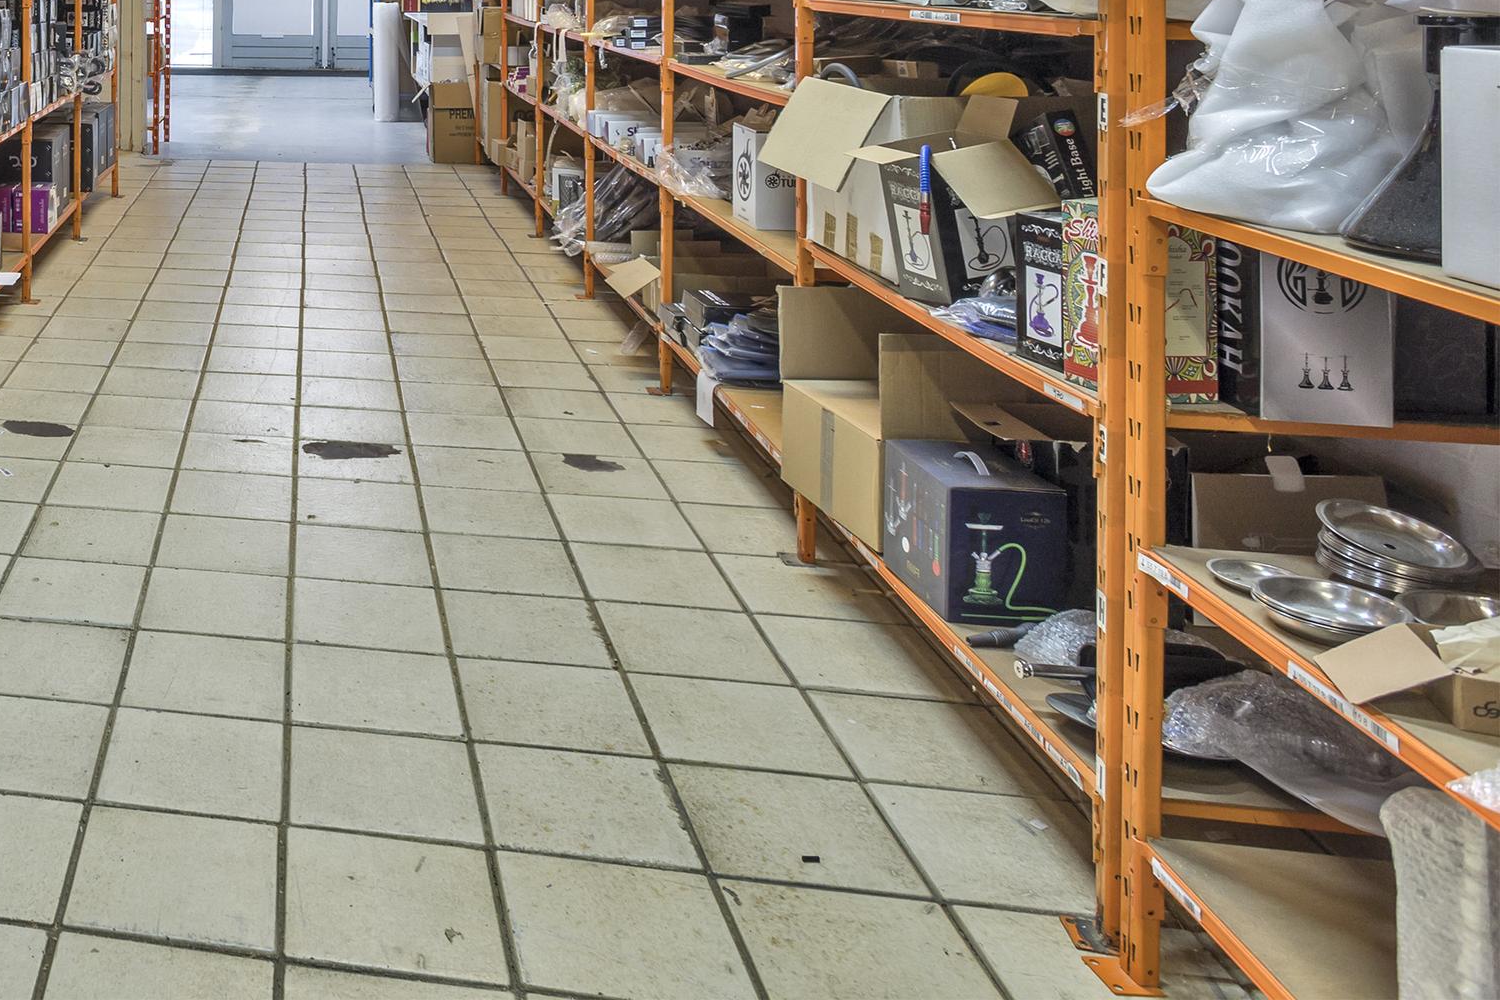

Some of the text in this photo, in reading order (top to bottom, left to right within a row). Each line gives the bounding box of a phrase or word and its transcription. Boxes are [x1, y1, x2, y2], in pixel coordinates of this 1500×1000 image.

[449, 109, 474, 120] PREM
[1066, 138, 1084, 166] Base
[1077, 166, 1095, 198] Light
[1217, 238, 1243, 375] OOKAH
